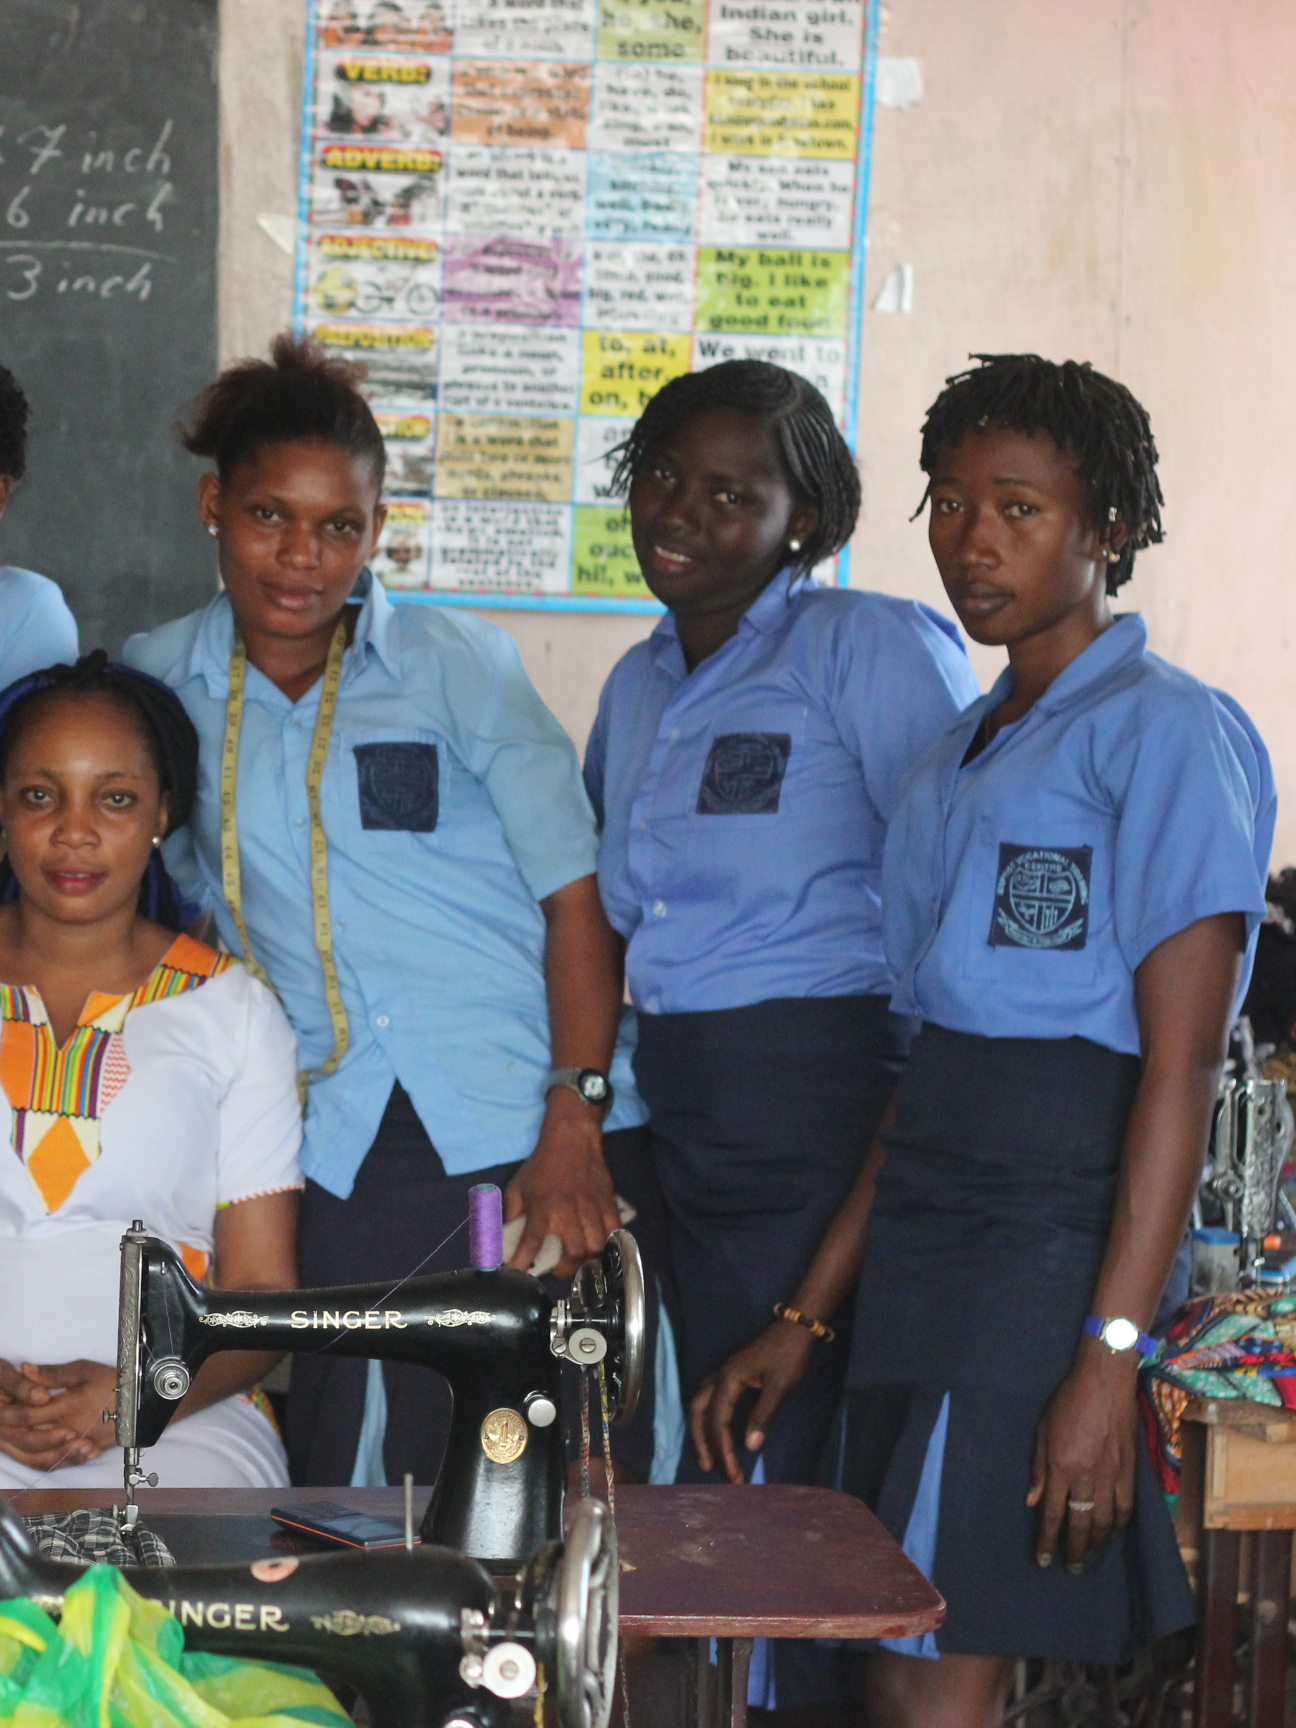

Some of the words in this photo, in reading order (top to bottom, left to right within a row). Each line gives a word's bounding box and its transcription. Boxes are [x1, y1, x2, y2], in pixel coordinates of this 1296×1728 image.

[721, 5, 796, 20] Indian
[807, 7, 853, 25] girl.
[751, 26, 794, 43] She
[804, 28, 823, 44] is
[618, 40, 685, 57] some
[727, 46, 844, 66] beautiful.
[81, 119, 172, 175] inch
[67, 181, 165, 233] inch
[715, 250, 750, 269] My
[759, 251, 803, 267] ball
[811, 252, 831, 268] is
[57, 262, 153, 301] inch
[785, 271, 829, 290] like
[736, 293, 759, 308] to
[768, 294, 806, 309] eat
[709, 312, 769, 331] good
[599, 334, 632, 357] to,
[642, 336, 676, 359] at,
[698, 338, 736, 359] We
[816, 342, 841, 363] to
[589, 390, 628, 411] on,
[290, 1309, 408, 1330] SINGER
[151, 1599, 290, 1633] INGER
